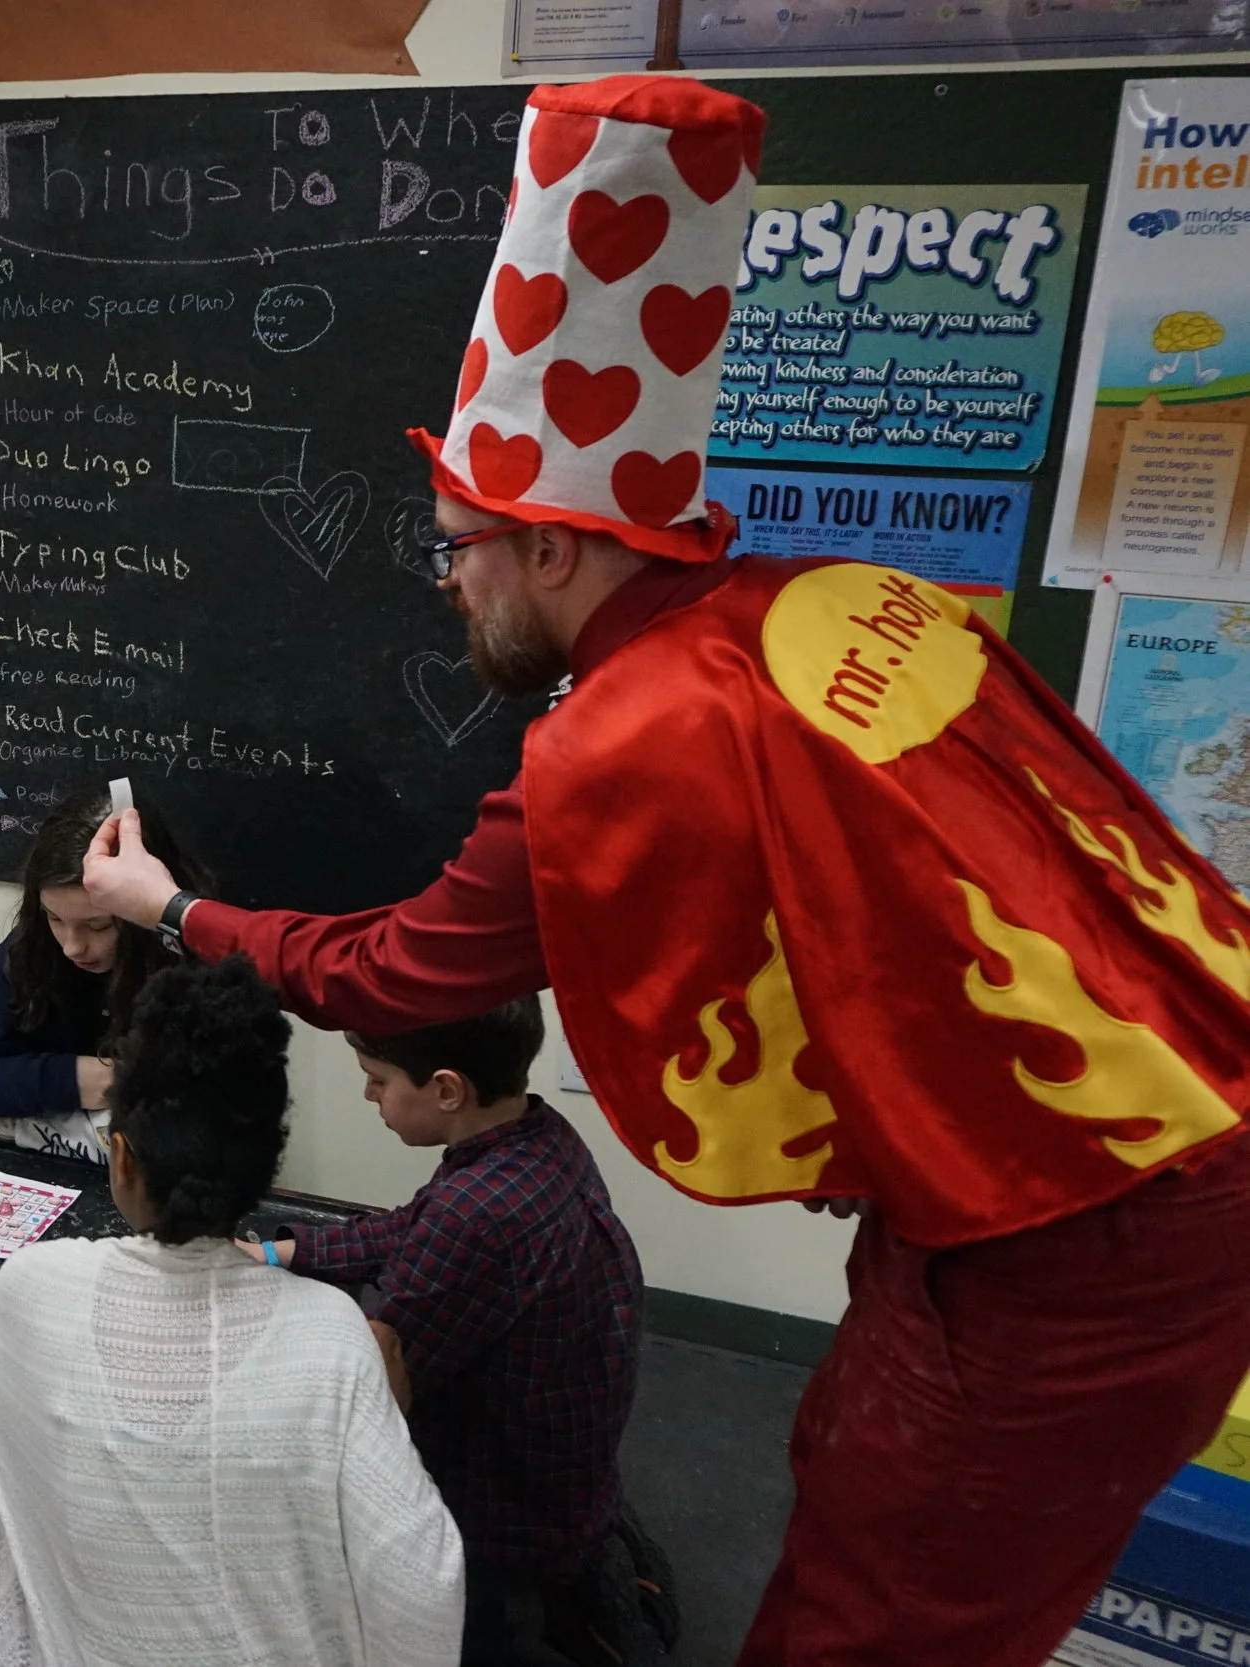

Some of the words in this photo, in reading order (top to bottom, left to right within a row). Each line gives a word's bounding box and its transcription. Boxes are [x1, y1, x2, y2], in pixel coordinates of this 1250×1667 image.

[264, 103, 331, 151] TO
[370, 90, 520, 151] Whe
[1143, 116, 1250, 149] How
[1135, 153, 1250, 190] intel
[271, 166, 337, 212] DO
[379, 158, 509, 231] Don
[1184, 224, 1238, 236] works
[1185, 206, 1250, 224] mindse
[2, 296, 75, 319] Maker
[85, 295, 160, 327] Space
[261, 288, 305, 308] John
[730, 305, 777, 332] ating
[784, 303, 845, 328] others
[853, 304, 884, 327] the
[891, 311, 933, 337] way
[938, 313, 974, 338] you
[981, 311, 1034, 330] want
[742, 326, 765, 350] be
[772, 331, 846, 352] treated
[103, 353, 253, 413] Academy
[720, 360, 768, 386] owing
[775, 357, 847, 382] kindness
[853, 359, 891, 382] and
[895, 361, 1018, 387] consideration
[5, 399, 54, 424] Hour
[64, 399, 86, 423] of
[93, 400, 137, 427] Code
[746, 387, 817, 412] yourself
[823, 392, 888, 419] enough
[897, 393, 916, 412] to
[926, 389, 949, 413] be
[954, 393, 1037, 420] yourself
[711, 416, 775, 444] cepting
[781, 416, 840, 438] others
[848, 418, 877, 443] for
[884, 422, 924, 441] who
[933, 422, 975, 448] they
[981, 431, 1017, 446] are
[62, 444, 152, 487] Lingo
[1137, 473, 1178, 486] explore
[2, 483, 119, 514] Homework
[747, 483, 803, 523] DID
[815, 487, 879, 527] YOU
[890, 491, 1011, 533] KNOW?
[1130, 487, 1175, 500] concept
[1137, 501, 1159, 511] new
[1121, 513, 1159, 524] formed
[1162, 515, 1205, 528] through
[1125, 528, 1168, 540] process
[1172, 531, 1205, 541] called
[905, 533, 933, 543] ACTION
[114, 544, 191, 580] Club
[847, 574, 942, 653] holt
[1126, 633, 1219, 655] EUROPE
[823, 647, 903, 729] mr.
[5, 705, 66, 734] Read
[73, 713, 194, 753] Current
[210, 727, 336, 776] Events
[0, 741, 85, 766] Organize
[95, 745, 178, 778] Library
